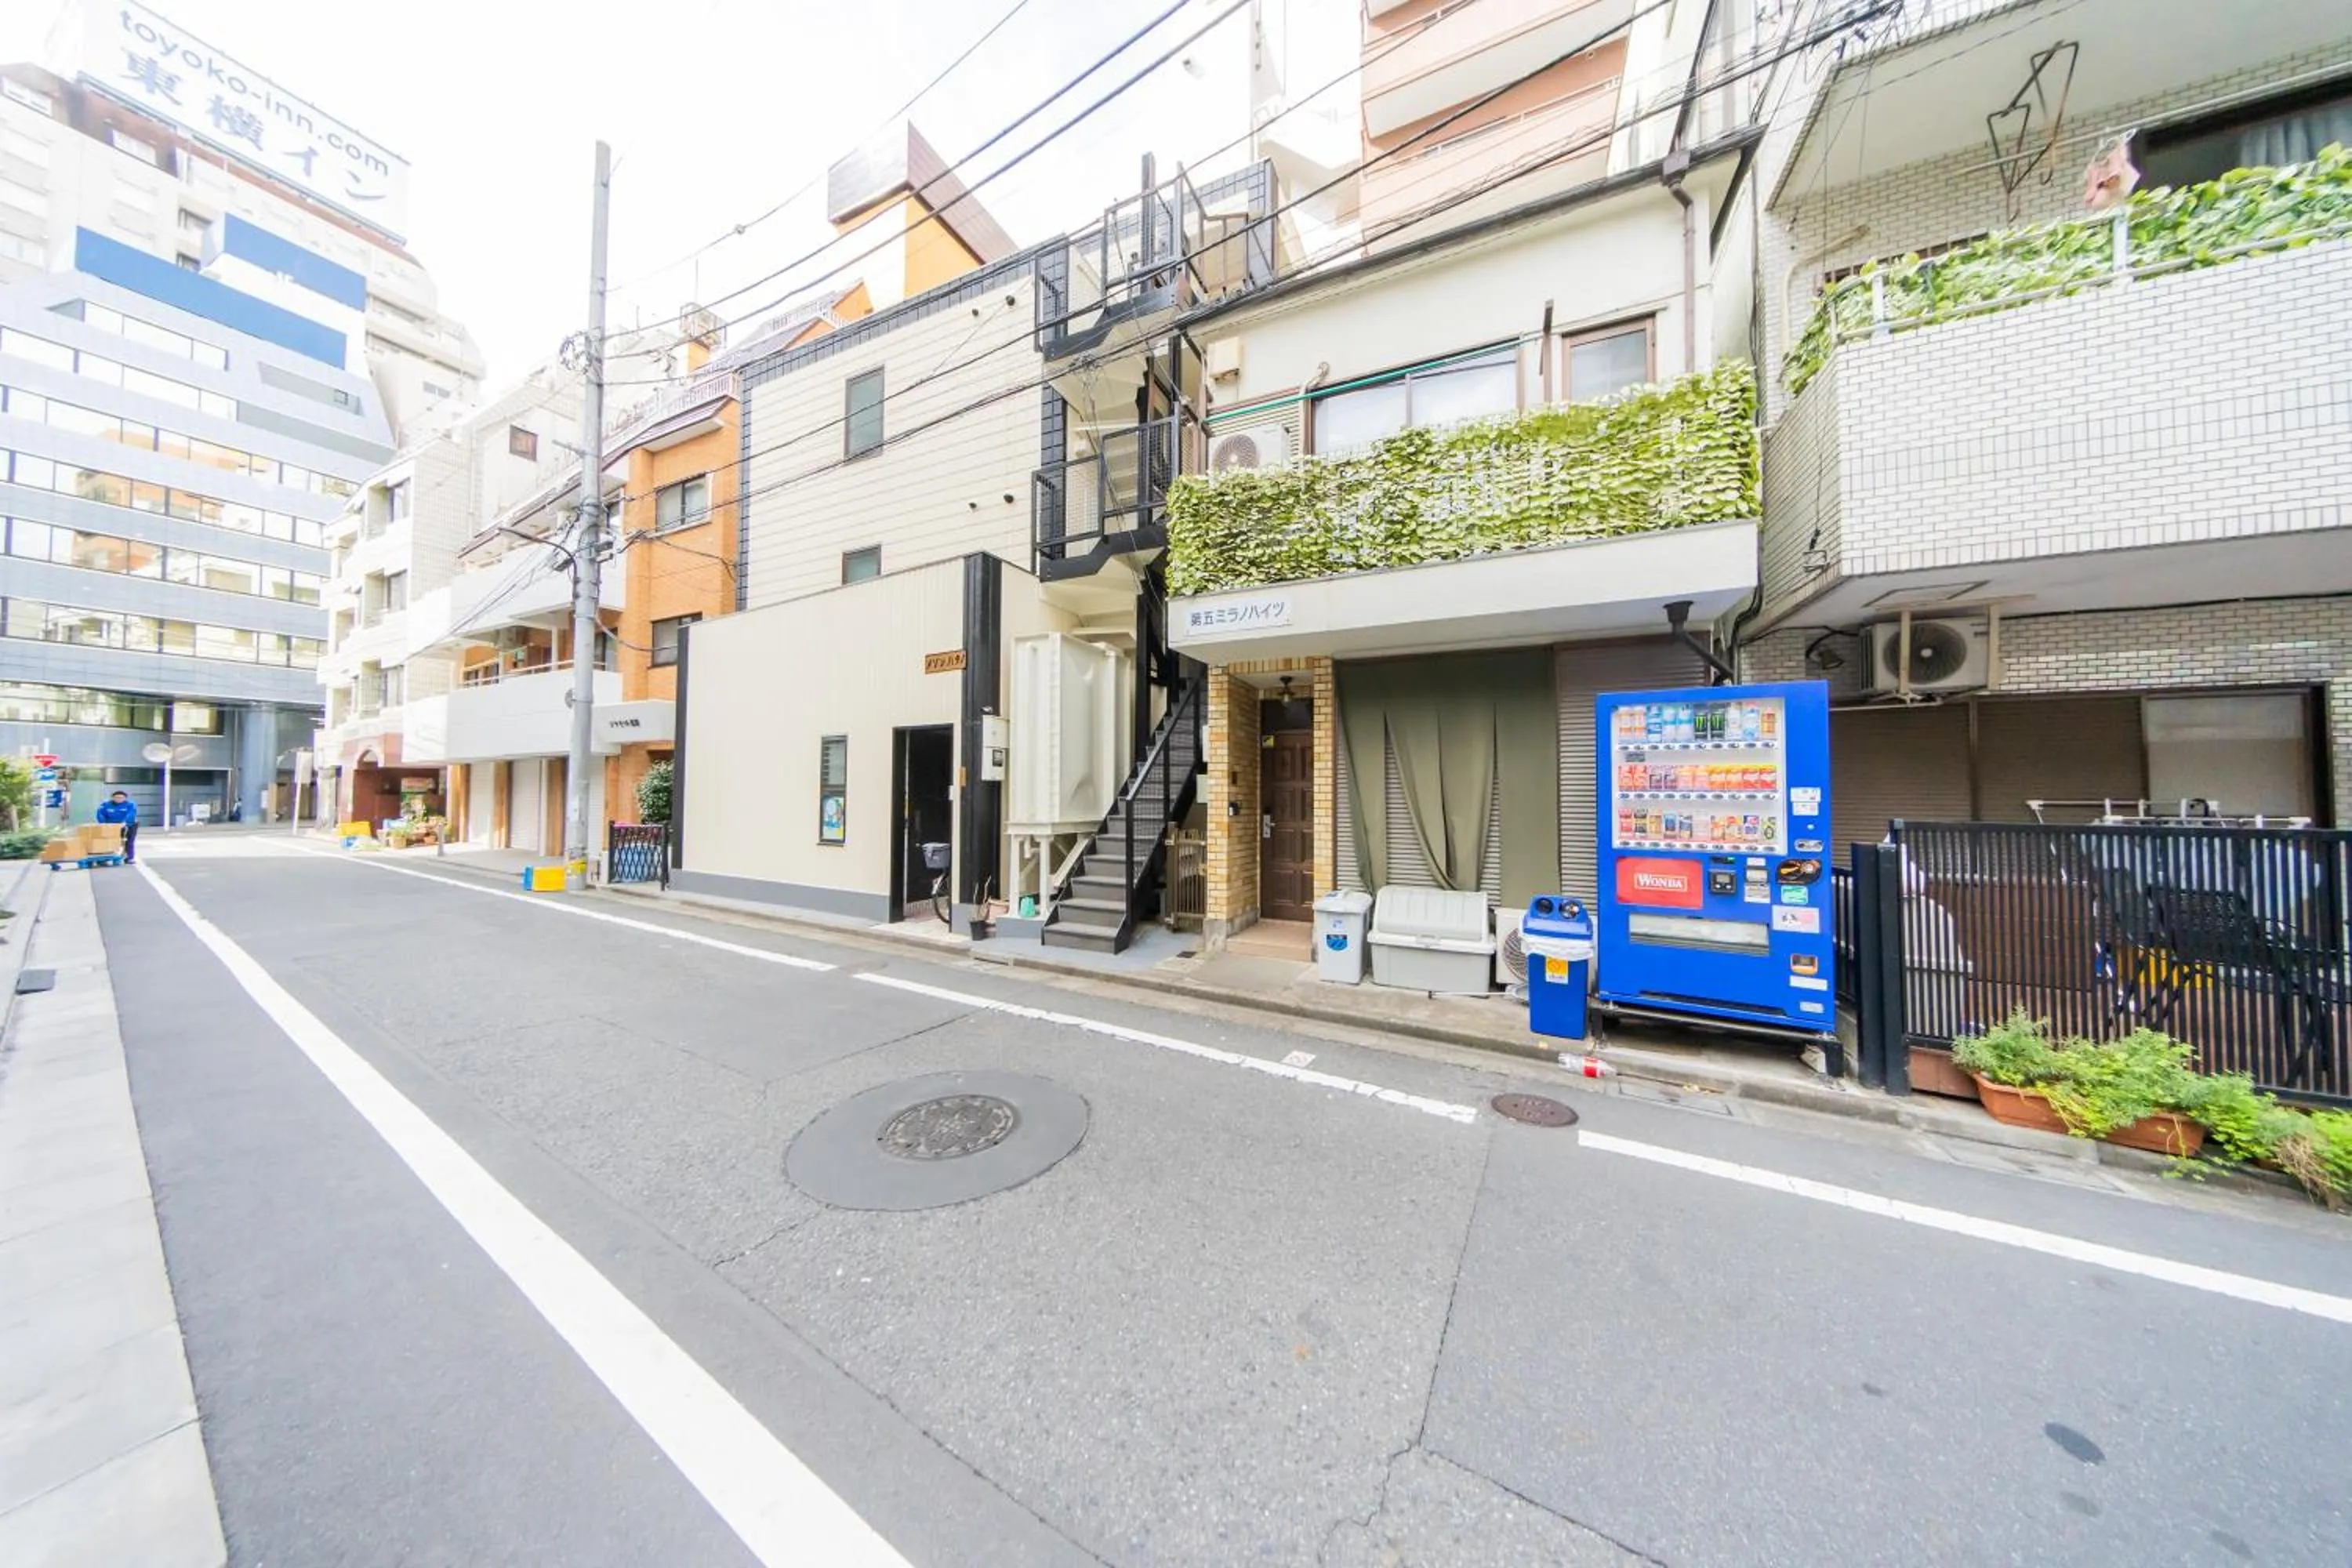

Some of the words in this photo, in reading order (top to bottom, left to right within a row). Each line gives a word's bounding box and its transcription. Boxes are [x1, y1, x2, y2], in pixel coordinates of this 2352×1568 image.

[118, 46, 387, 201] 東横イン
[120, 9, 390, 177] toyoko-inn.com
[1190, 601, 1286, 626] 第五ミラノハイツ
[1636, 872, 1684, 889] WONDA
